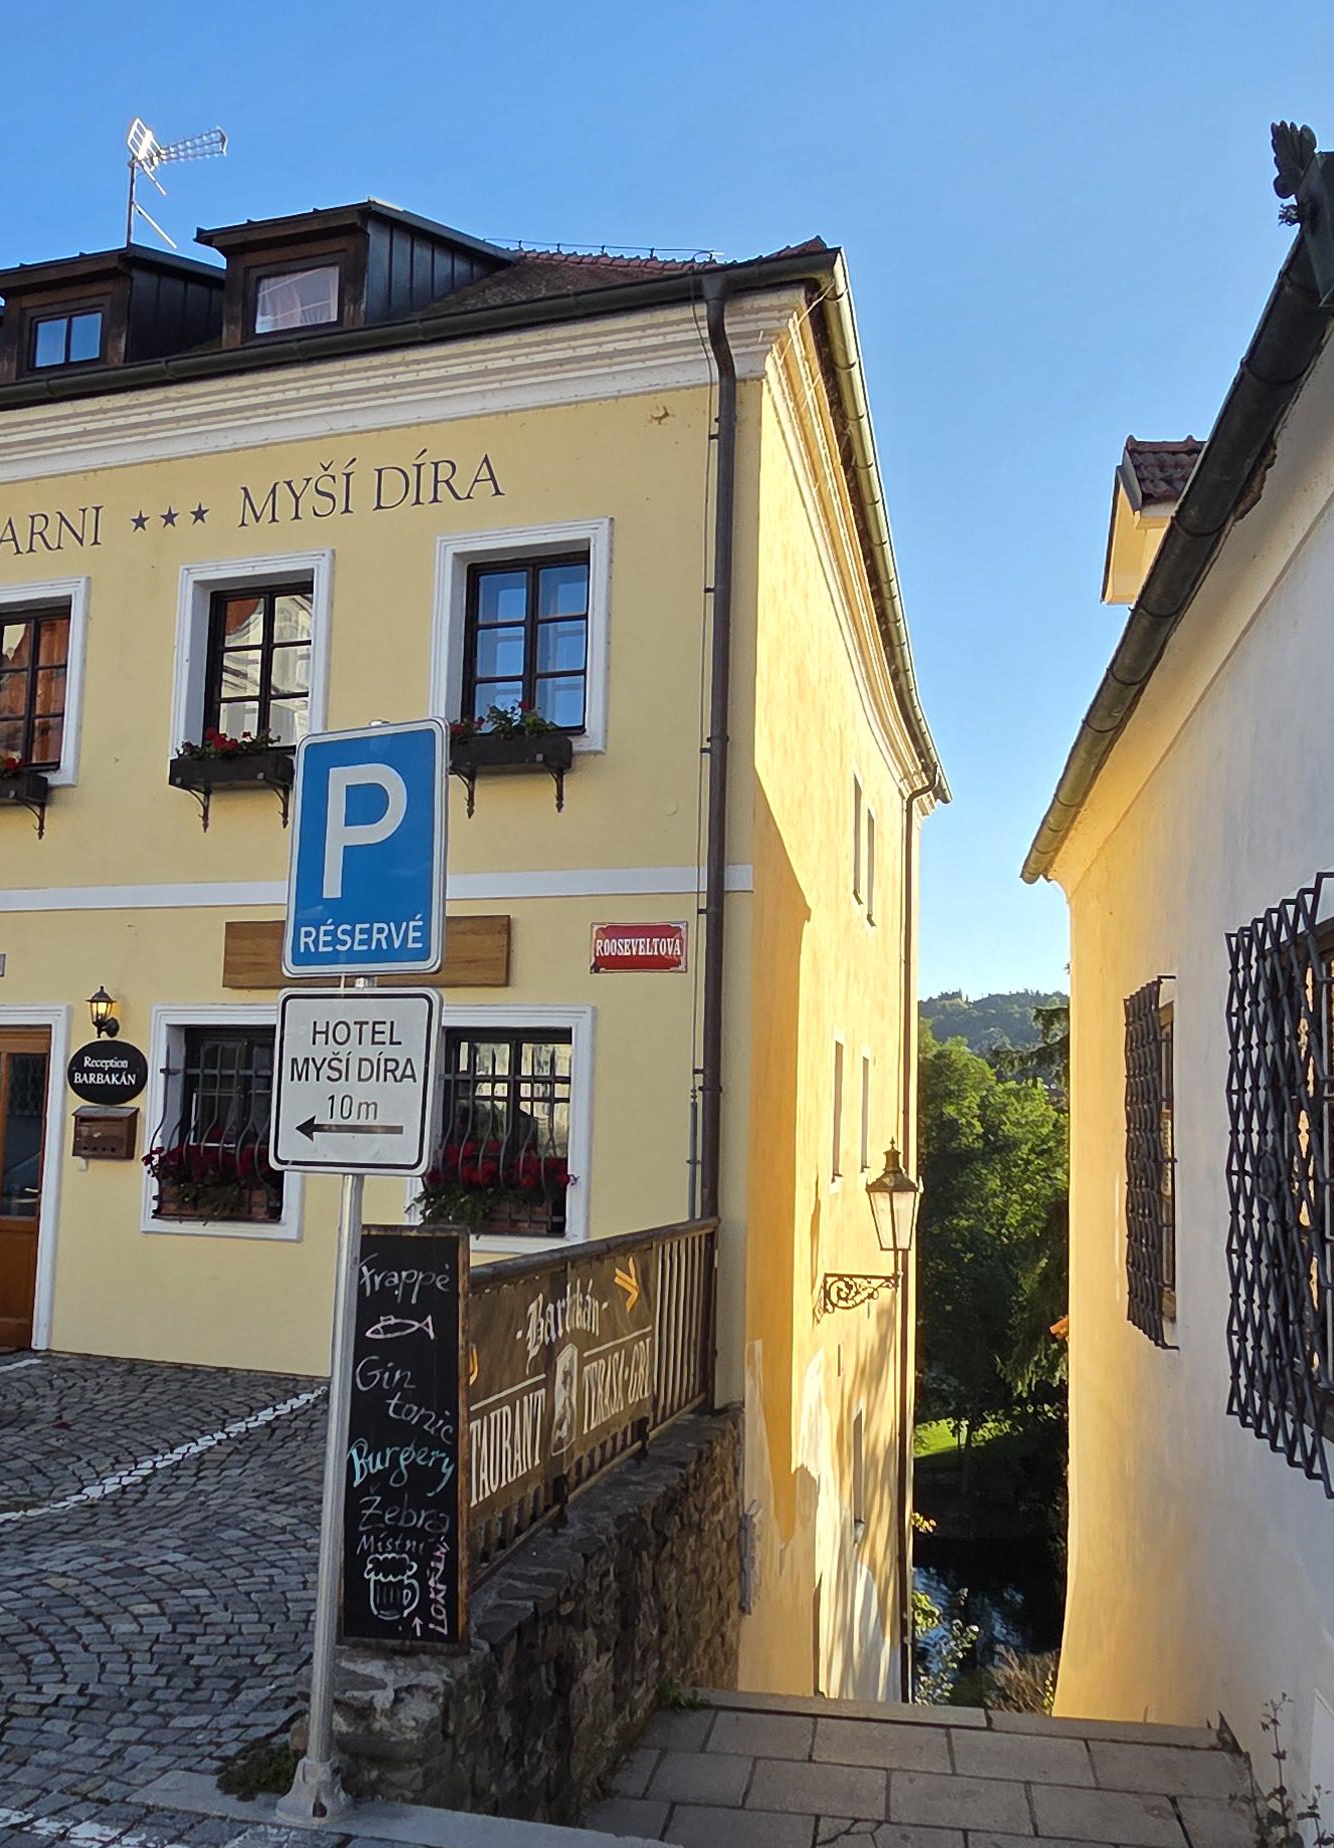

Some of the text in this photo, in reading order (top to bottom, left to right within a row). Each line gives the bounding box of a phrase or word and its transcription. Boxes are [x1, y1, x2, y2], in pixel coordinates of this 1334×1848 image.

[237, 457, 356, 529] MYŠÍ
[372, 448, 506, 513] DÍRA
[322, 762, 408, 899] P
[299, 914, 424, 954] RÉSERVÉ
[595, 937, 682, 957] ROOSEVELTOVA
[311, 1020, 403, 1047] HOTEL
[73, 1070, 137, 1086] BARBAKÁN
[83, 1056, 129, 1071] Reception
[289, 1050, 418, 1084] MYŠÍ DÍRA
[355, 1355, 417, 1391] Gin
[386, 1391, 454, 1445] tonic
[470, 1388, 547, 1508] TAURANT
